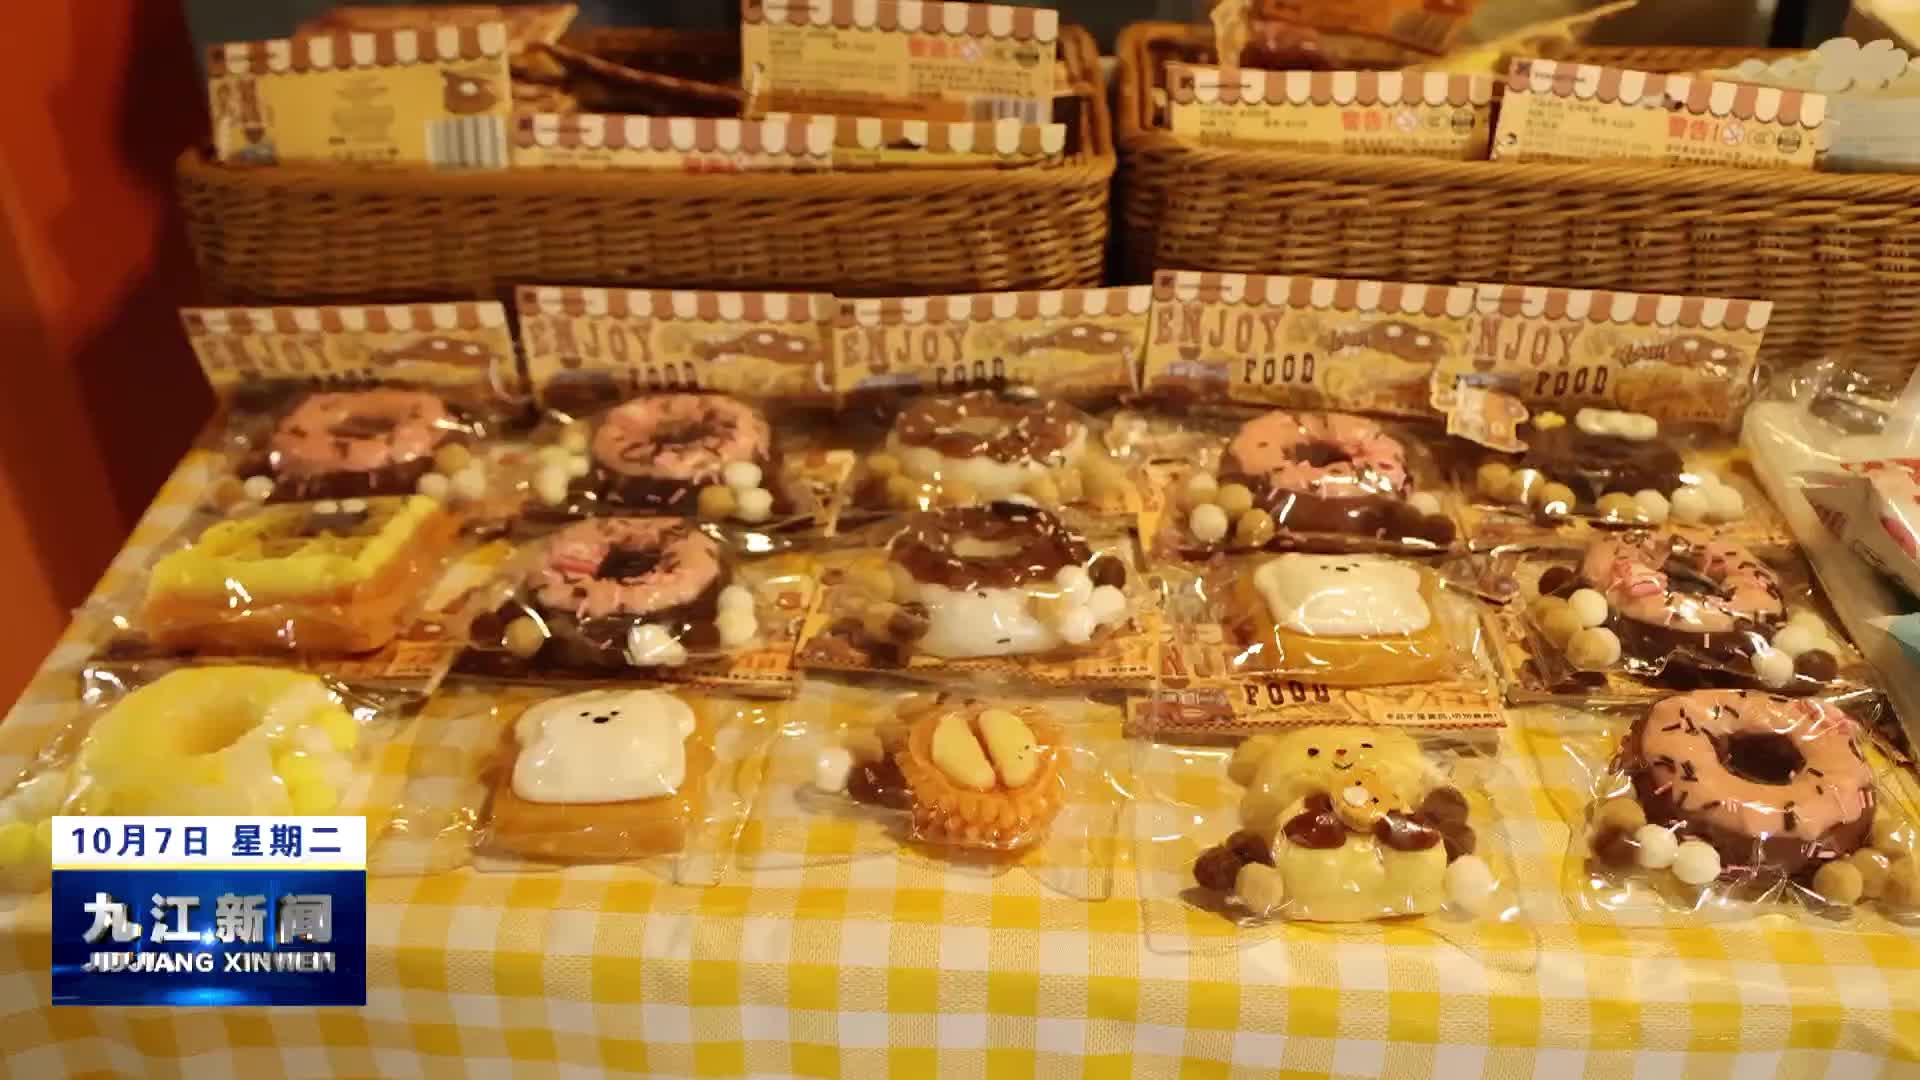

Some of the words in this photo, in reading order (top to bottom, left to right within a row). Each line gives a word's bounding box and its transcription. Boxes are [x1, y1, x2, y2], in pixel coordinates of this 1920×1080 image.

[530, 315, 653, 363] ENJOY
[841, 322, 970, 367] ENJOY
[1153, 302, 1285, 352] ENJOY
[1244, 352, 1314, 384] FOOD
